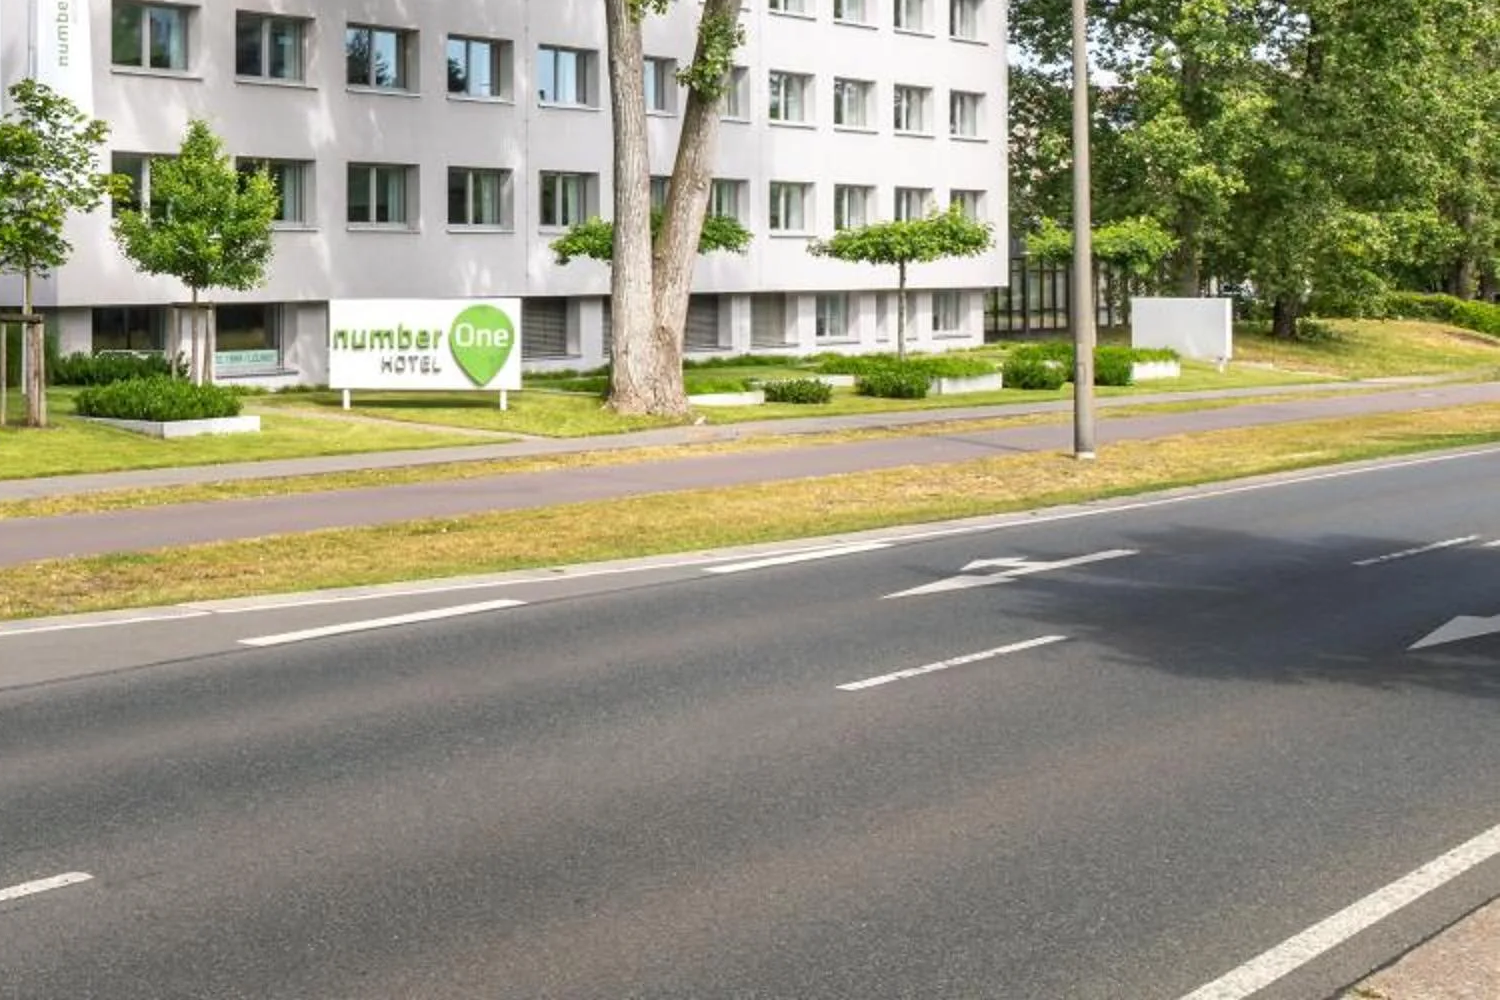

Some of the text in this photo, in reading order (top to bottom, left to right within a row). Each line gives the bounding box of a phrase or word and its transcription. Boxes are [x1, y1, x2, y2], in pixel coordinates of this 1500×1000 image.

[333, 323, 509, 351] number One
[380, 354, 443, 374] HOTEL
